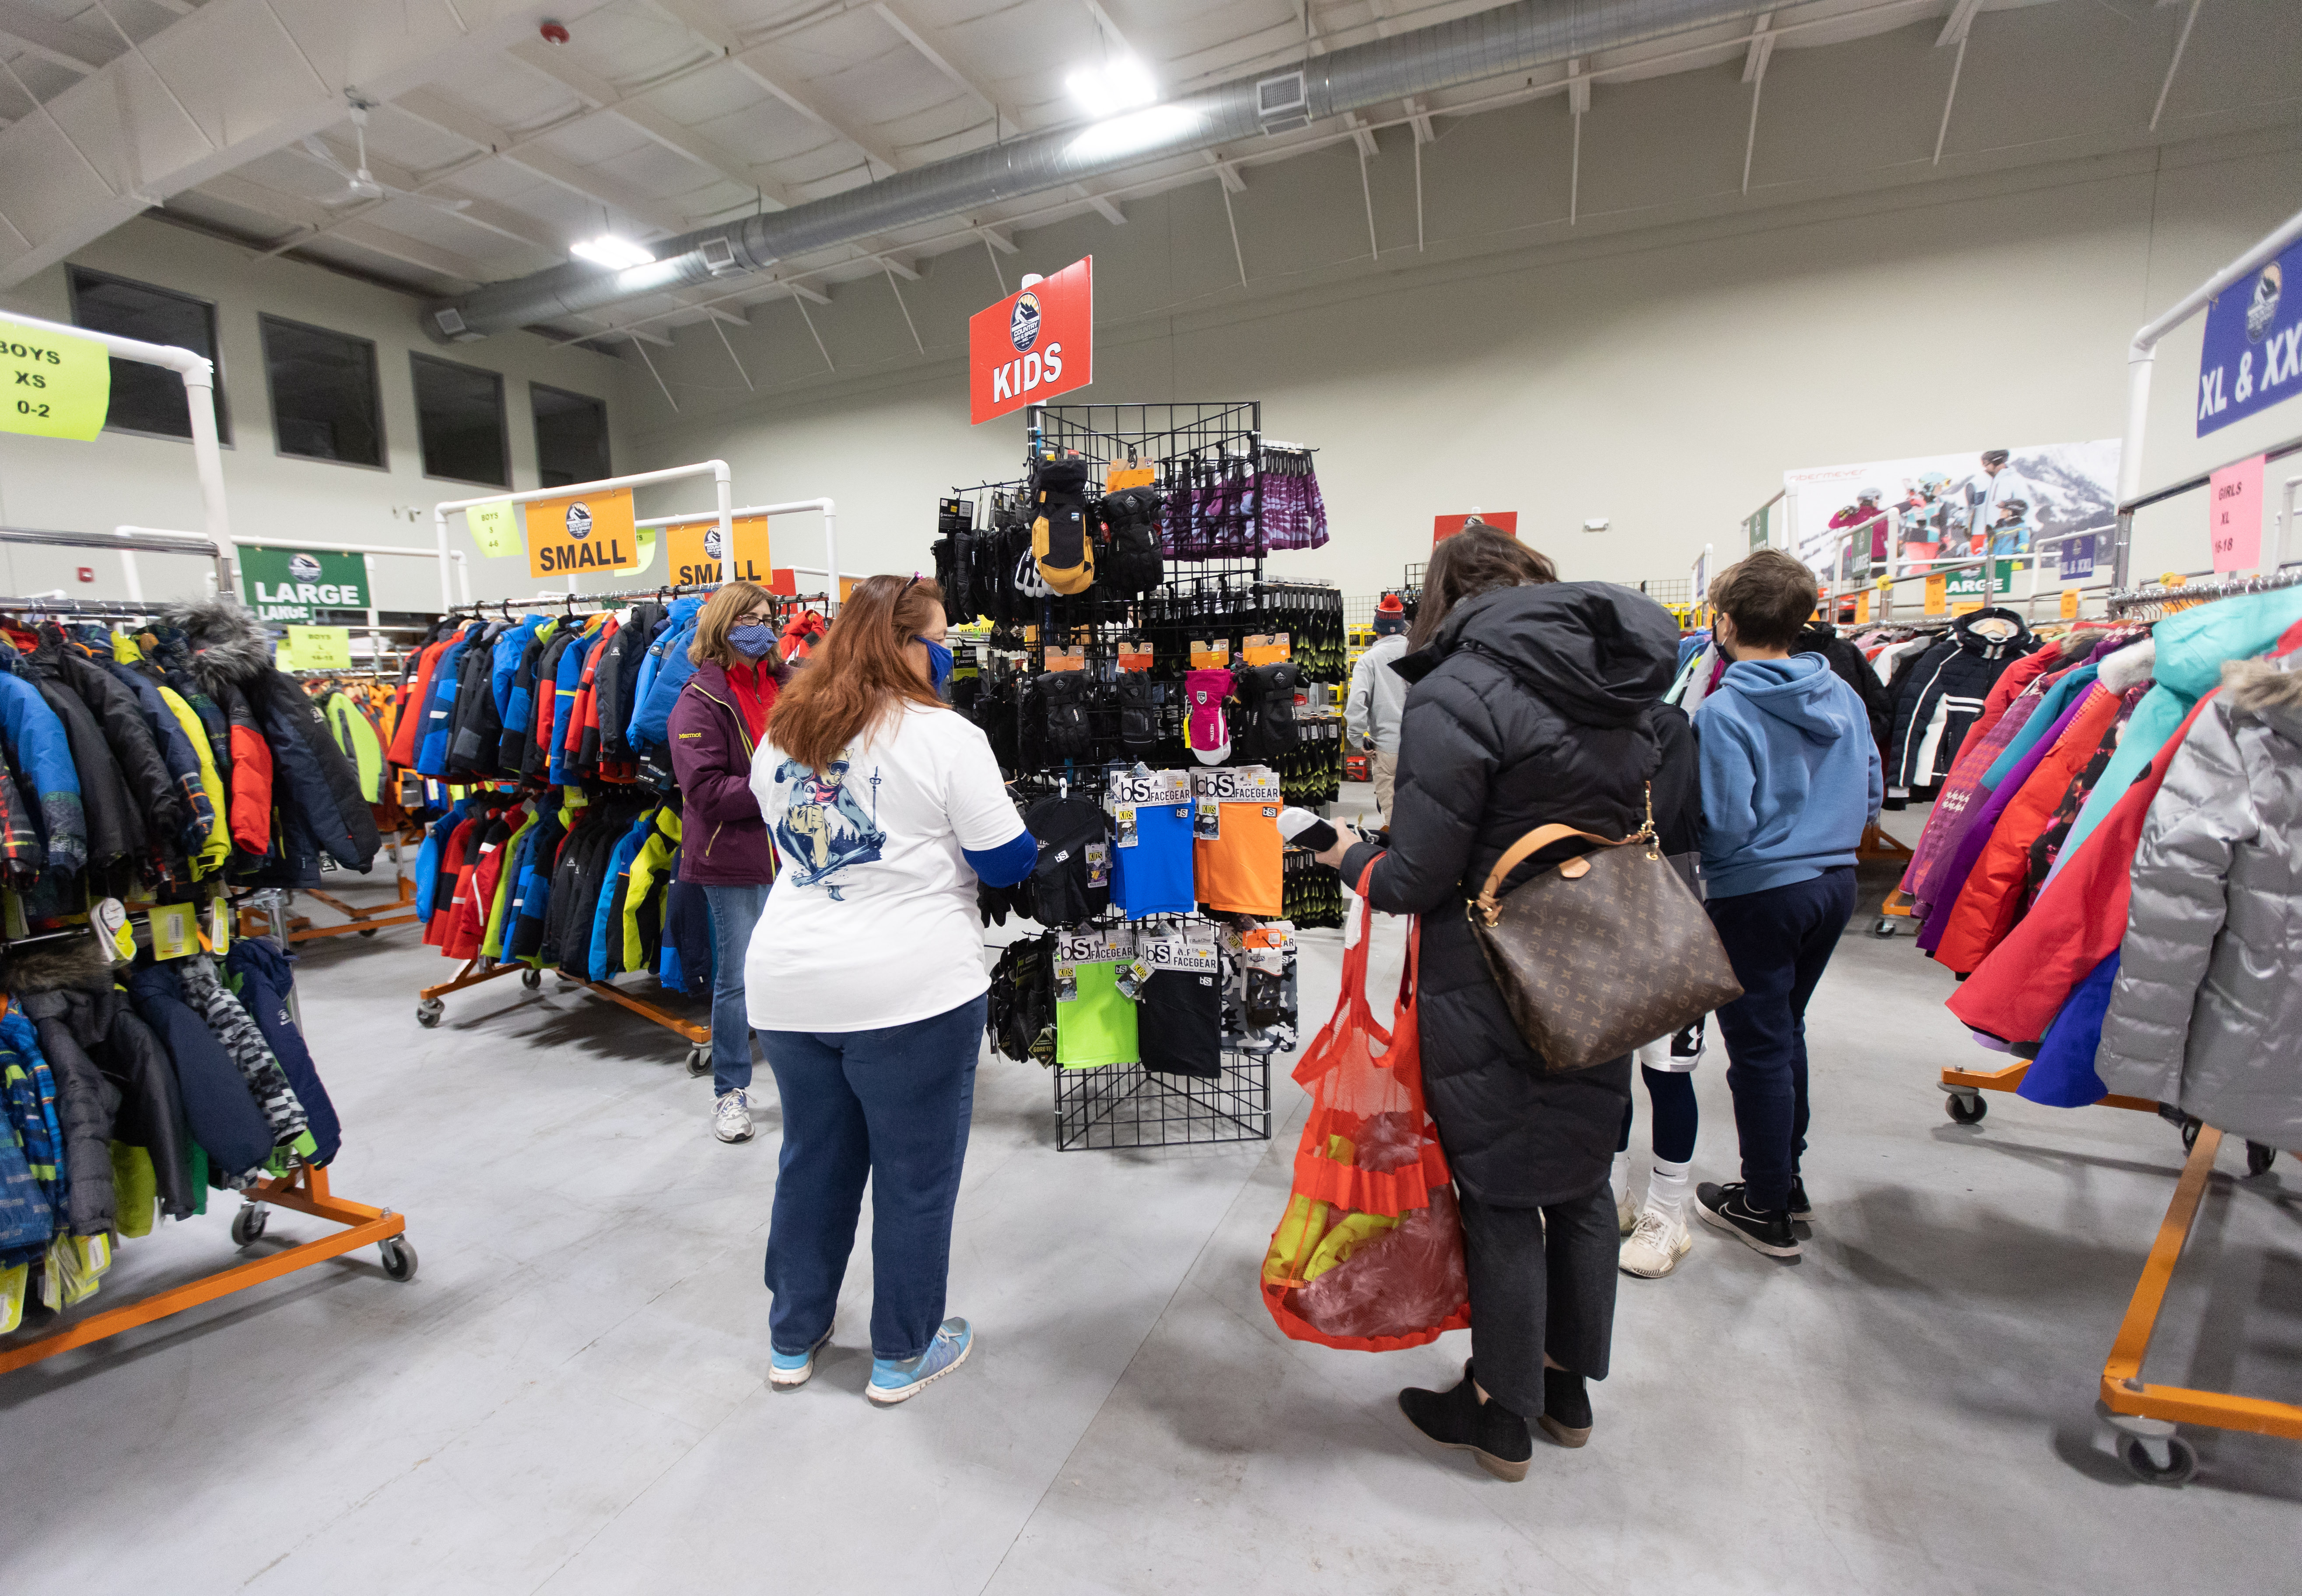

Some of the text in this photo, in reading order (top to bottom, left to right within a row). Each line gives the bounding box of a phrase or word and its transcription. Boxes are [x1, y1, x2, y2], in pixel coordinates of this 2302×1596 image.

[1014, 321, 1038, 337] COUNTRY
[1024, 327, 1038, 337] SPORT
[0, 340, 60, 365] BOYS
[993, 342, 1062, 403] KIDS
[2199, 322, 2302, 420] XL & XX
[14, 370, 46, 388] XS
[18, 400, 49, 418] 0-2
[2219, 482, 2242, 500] GIRLS
[481, 512, 498, 521] BOYS
[2221, 511, 2229, 525] XL
[540, 539, 626, 571] SMALL
[1945, 578, 2003, 593] ARGE
[255, 581, 360, 605] LARGE
[257, 605, 309, 621] LARGE
[1151, 789, 1190, 802] FACEGEAR
[1236, 788, 1278, 798] FACEGEAR
[1119, 810, 1133, 820] KIDS
[1202, 805, 1216, 814] KIDS
[1263, 808, 1274, 816] bS
[1089, 852, 1102, 861] KIDS
[1091, 947, 1132, 959] FACEGEAR
[1174, 957, 1216, 969] FACEGEAR
[1059, 968, 1073, 977] KIDS
[1134, 963, 1147, 979] KIDS
[1200, 976, 1210, 985] bS
